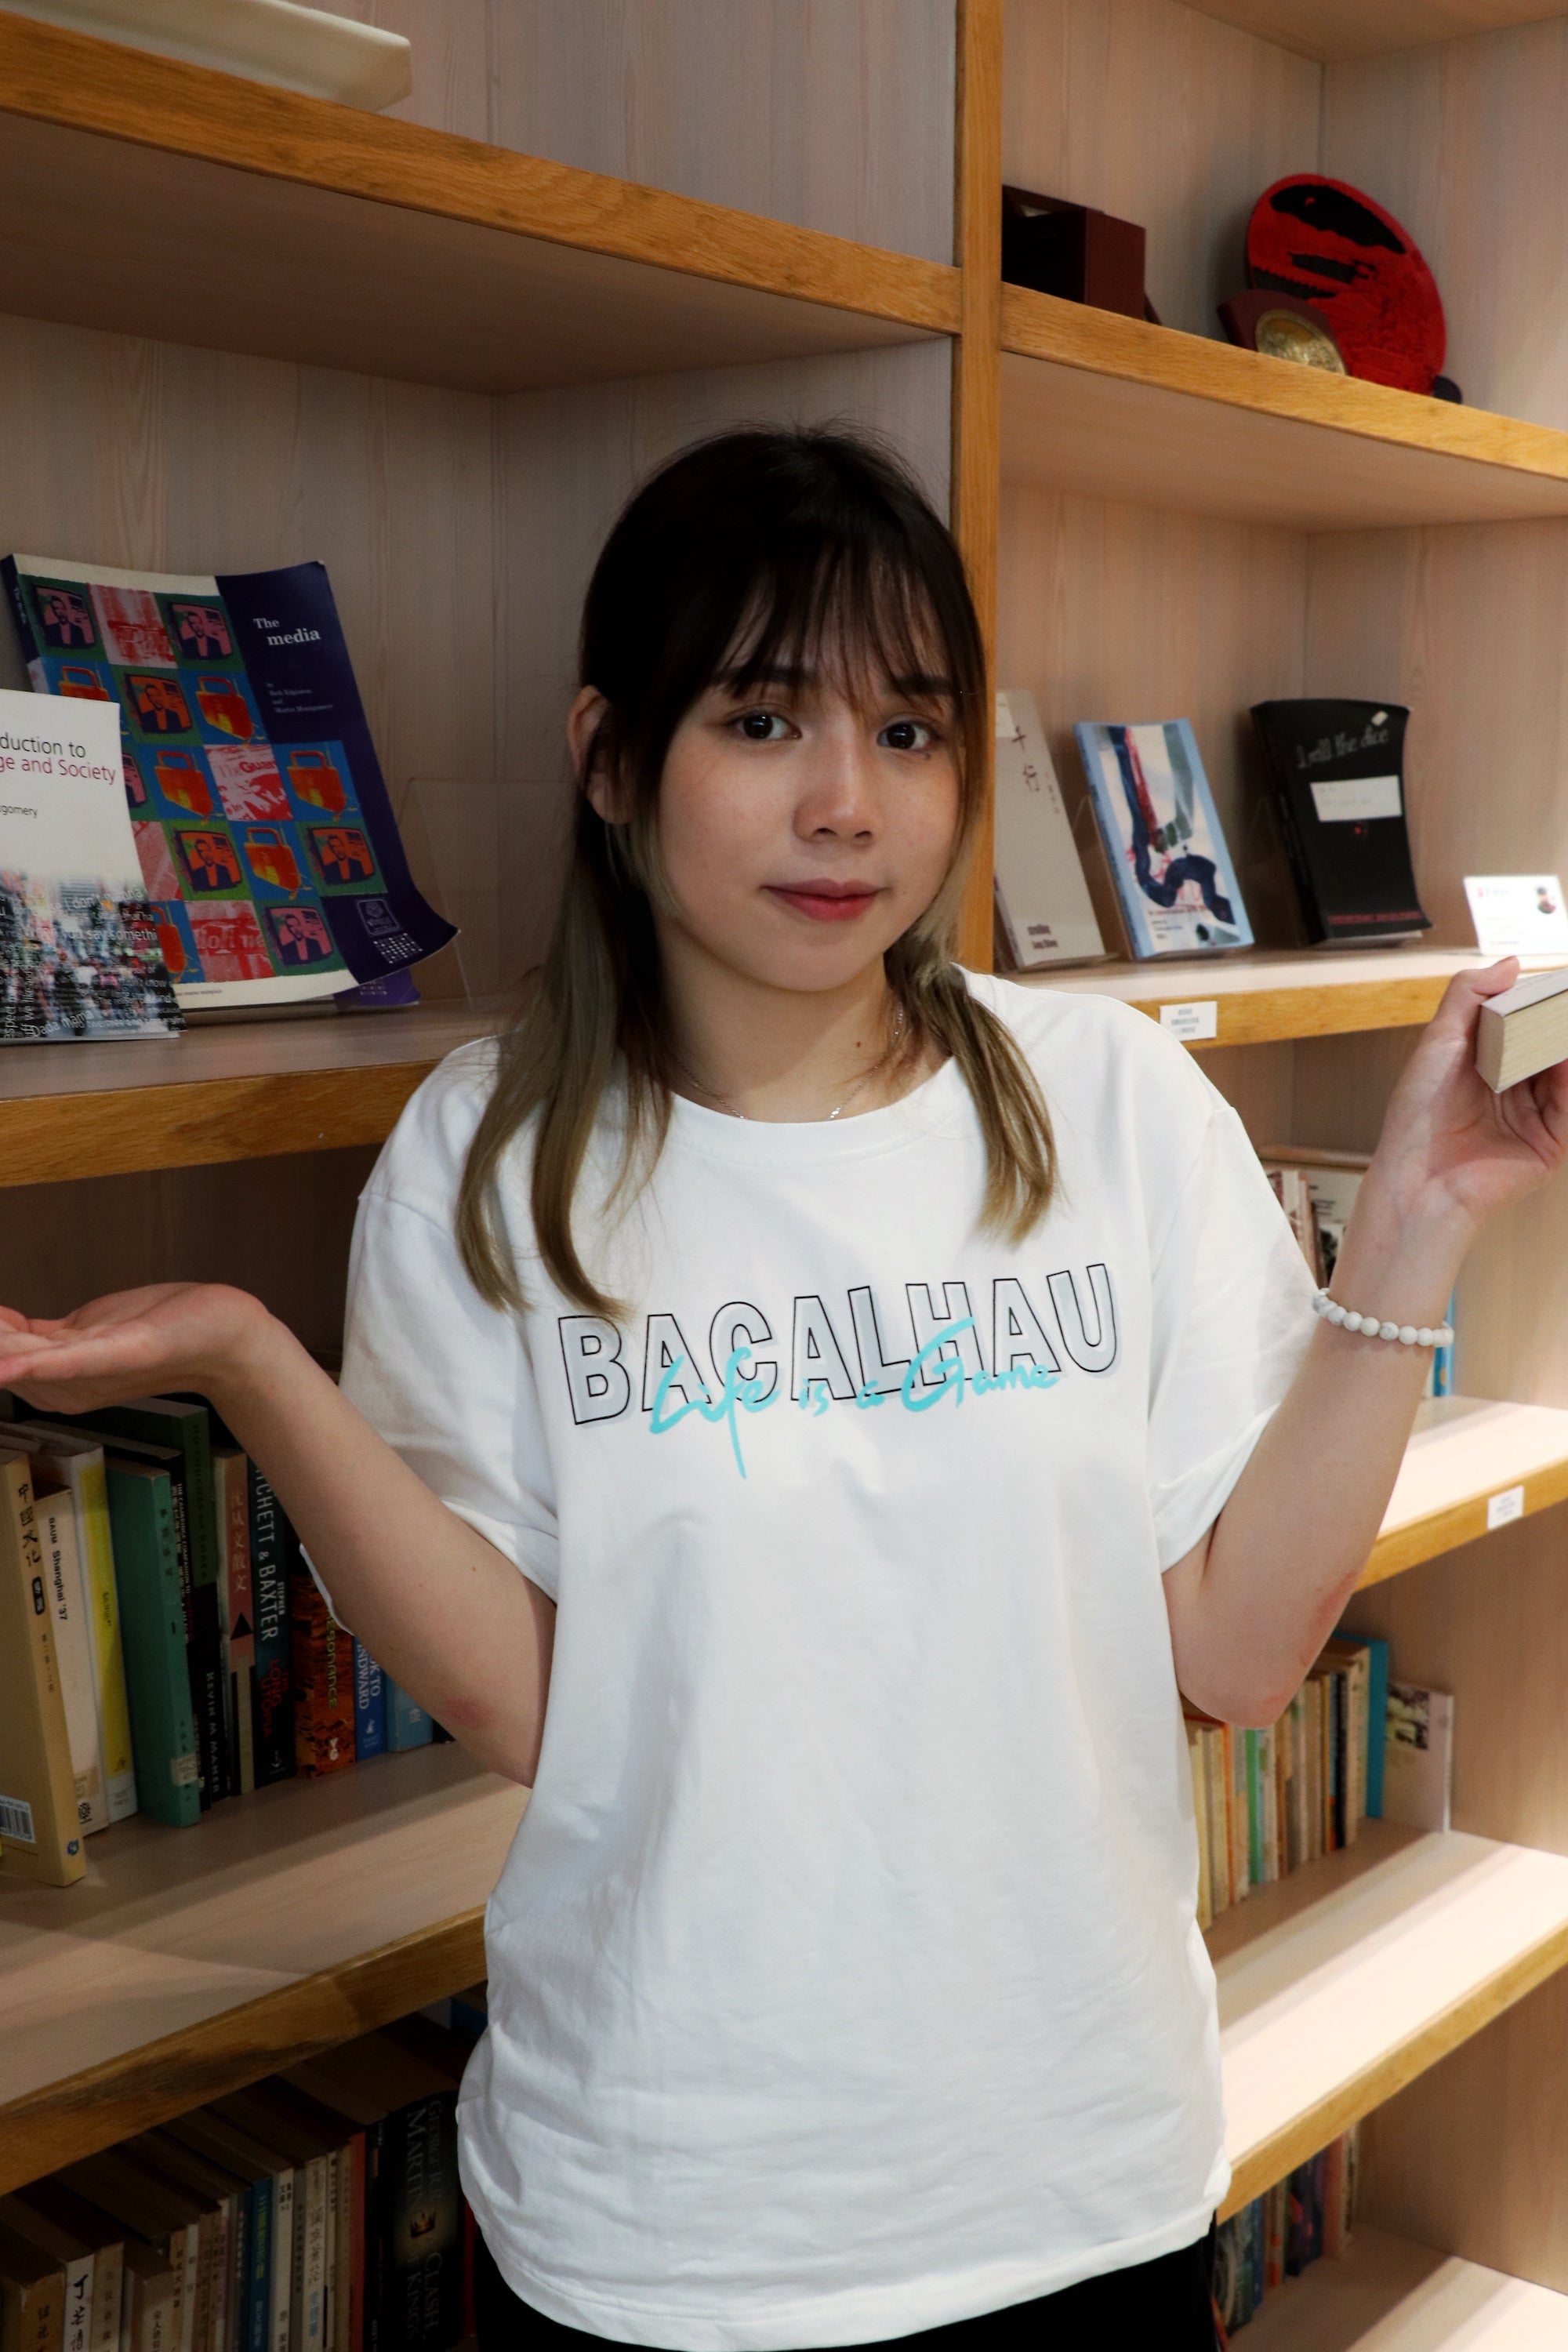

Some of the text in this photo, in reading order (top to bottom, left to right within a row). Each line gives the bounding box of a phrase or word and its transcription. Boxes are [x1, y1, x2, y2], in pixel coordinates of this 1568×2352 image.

[253, 618, 279, 628] The
[267, 628, 321, 645] media
[21, 757, 52, 774] and
[58, 759, 115, 785] Society
[68, 742, 85, 757] to
[557, 1263, 1118, 1426] BACALHAU
[649, 1317, 1059, 1480] Life is a Game
[48, 1517, 58, 1544] BAUM
[53, 1550, 66, 1602] Shanghai
[258, 1551, 270, 1561] &
[258, 1564, 279, 1642] BAXTER
[206, 1671, 216, 1717] KEVIN
[370, 1675, 381, 1697] TO
[407, 2103, 429, 2211] MARTIN
[423, 2251, 444, 2332] CLASH
